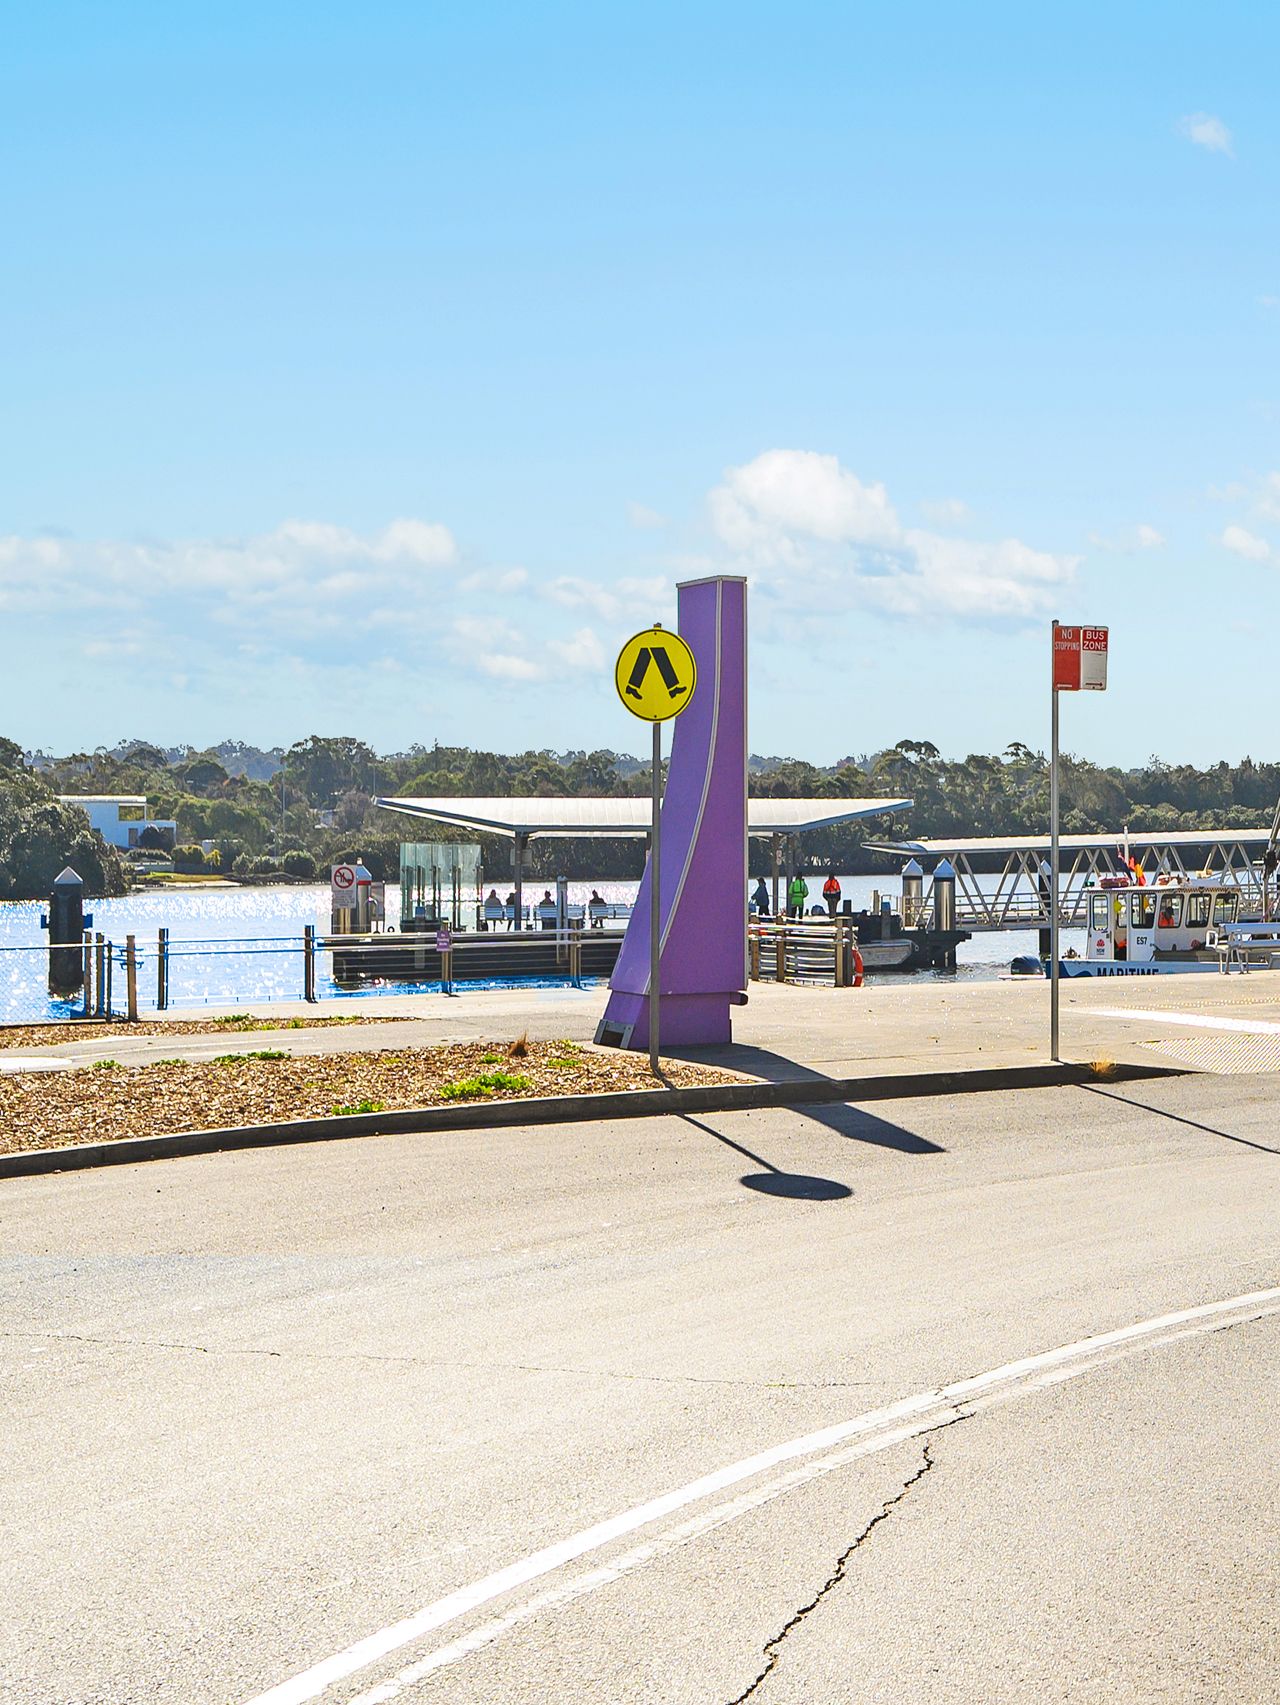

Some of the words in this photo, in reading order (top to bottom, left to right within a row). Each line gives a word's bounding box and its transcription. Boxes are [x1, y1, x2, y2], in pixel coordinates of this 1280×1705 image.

[1062, 629, 1073, 640] NO
[1086, 631, 1104, 640] BUS
[1054, 642, 1080, 651] STOPPING
[1083, 641, 1106, 650] ZONE
[1136, 936, 1148, 945] ES7
